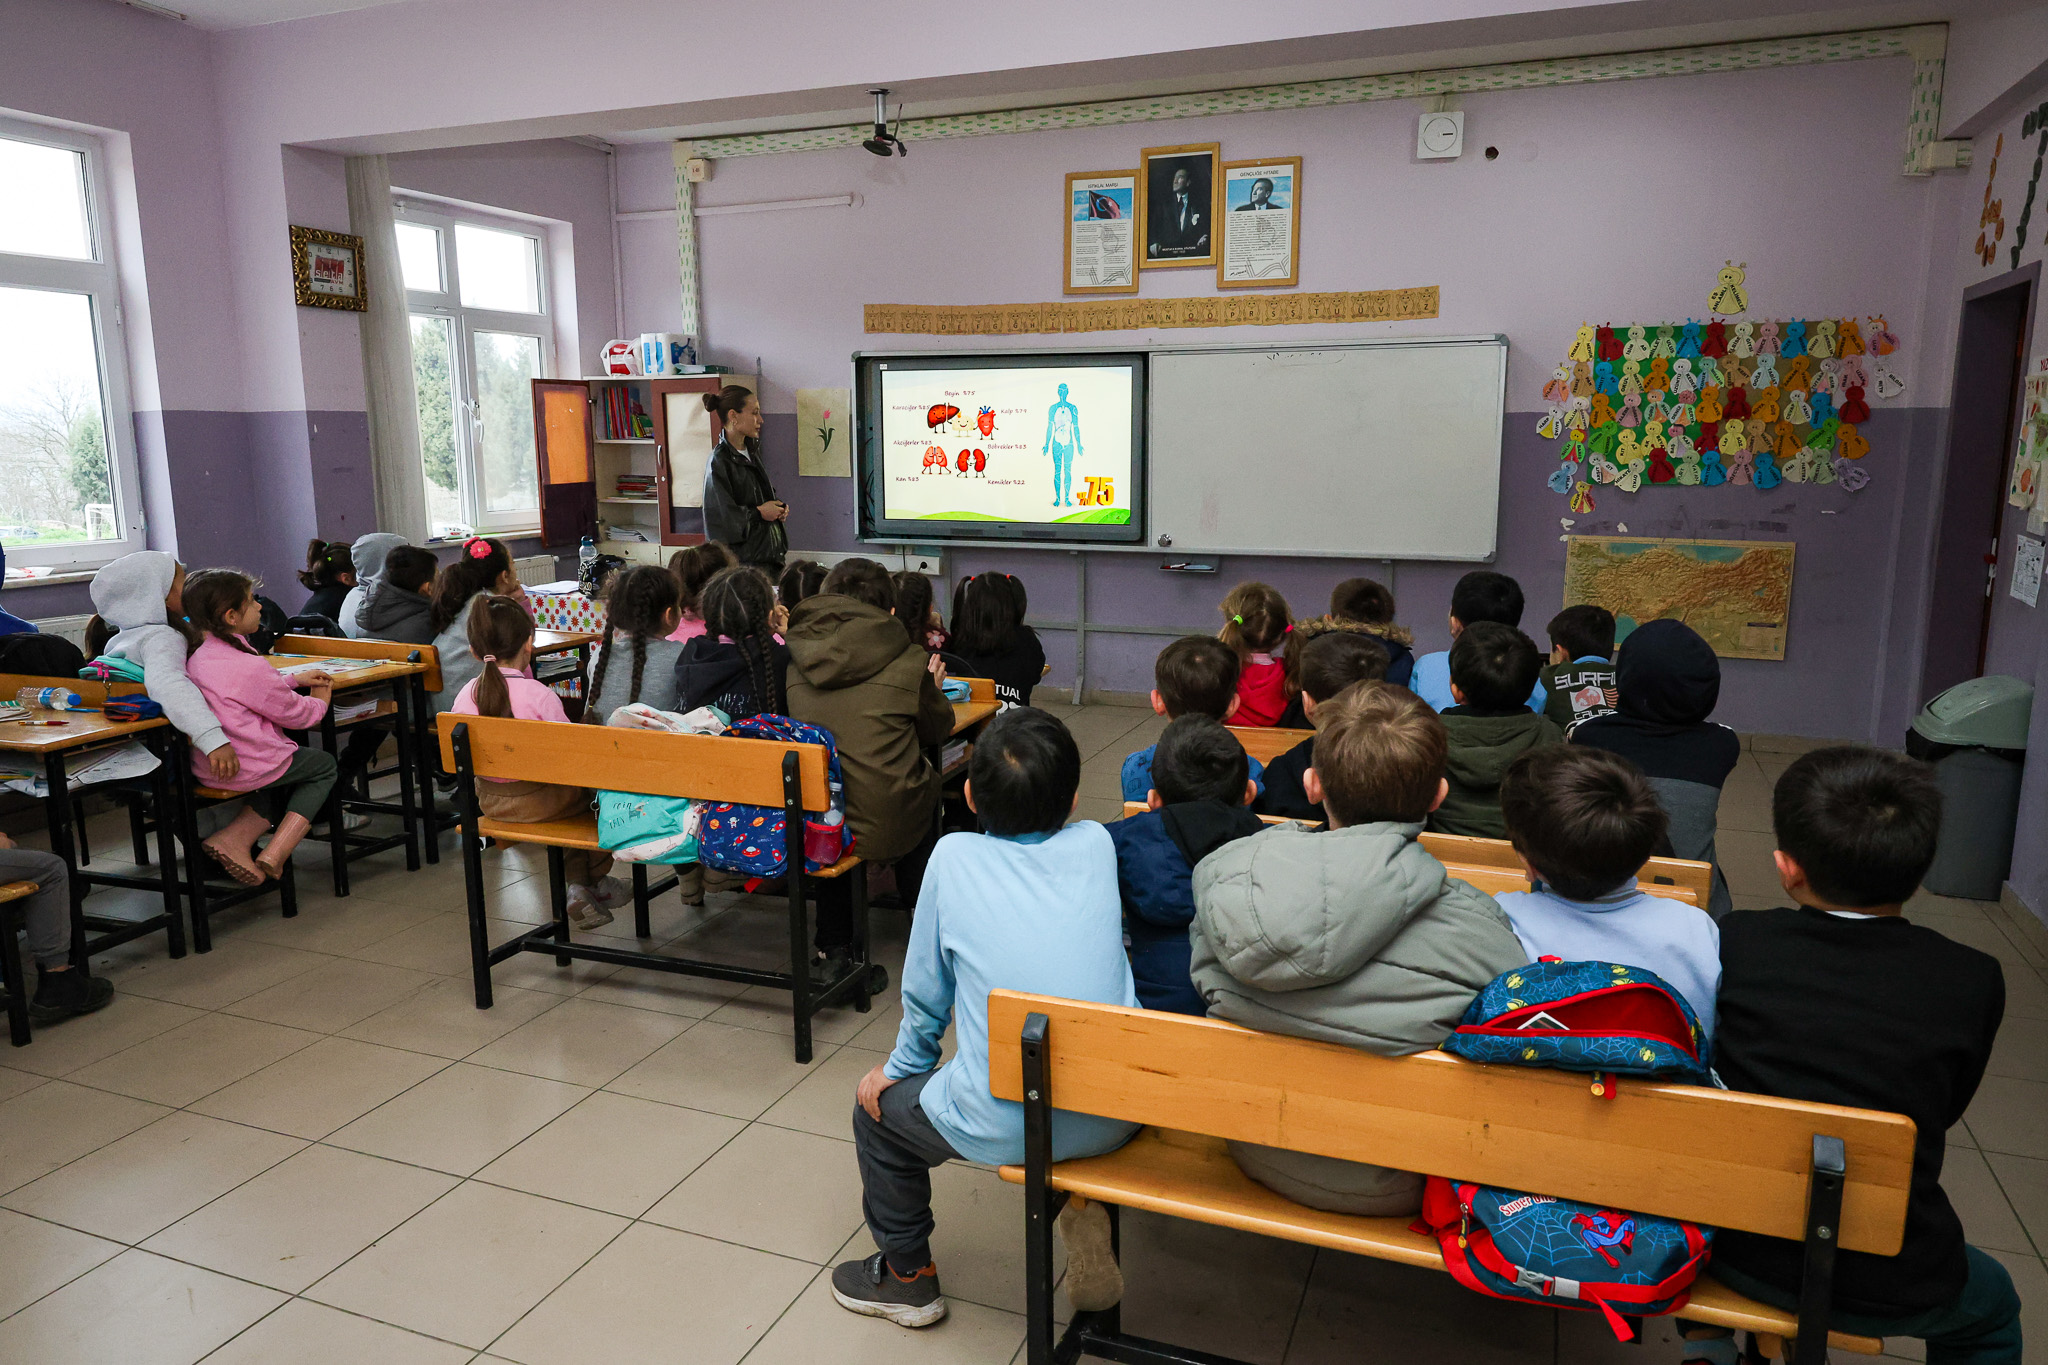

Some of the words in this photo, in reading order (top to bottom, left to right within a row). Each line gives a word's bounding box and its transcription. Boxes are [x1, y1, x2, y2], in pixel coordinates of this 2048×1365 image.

[1712, 286, 1728, 311] ANLAMLI
[1539, 417, 1549, 429] HARP
[1076, 476, 1114, 506] %75
[1499, 1196, 1533, 1216] Super
